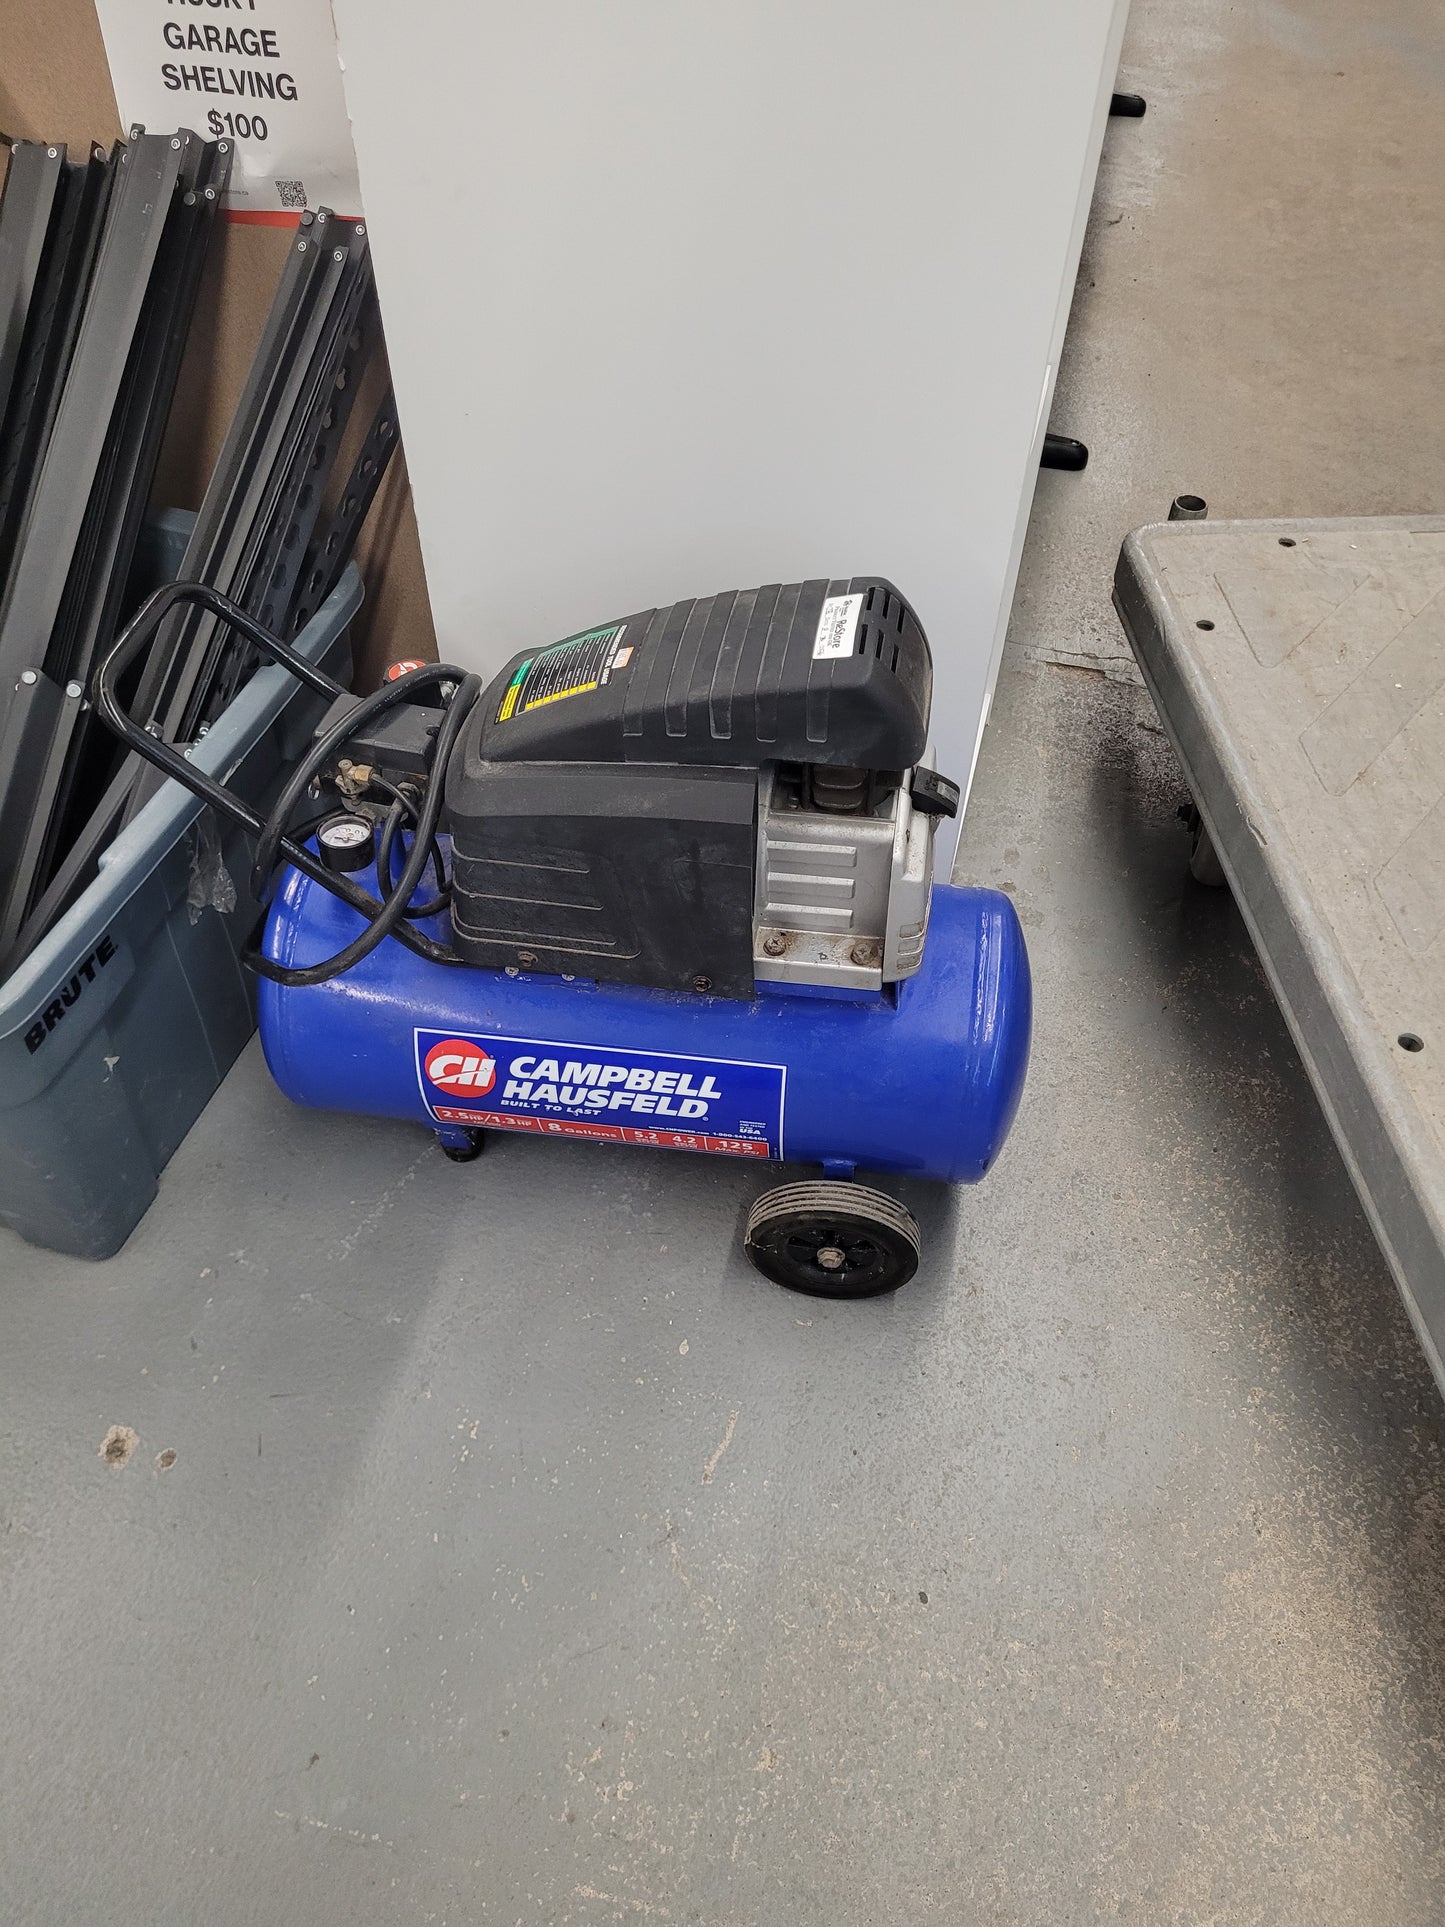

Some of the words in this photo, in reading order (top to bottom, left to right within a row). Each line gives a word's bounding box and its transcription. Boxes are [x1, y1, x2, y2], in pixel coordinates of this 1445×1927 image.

[163, 22, 280, 58] GARAGE
[161, 63, 298, 101] SHELVING
[207, 108, 268, 141] $100
[24, 935, 116, 1054] BRUTE
[509, 1056, 722, 1098] CAMPBELL
[500, 1100, 540, 1109] BUILT
[545, 1104, 562, 1112] TO
[566, 1107, 602, 1117] LAST
[502, 1080, 709, 1119] HAUSFELD
[548, 1123, 562, 1133] 8
[563, 1127, 617, 1139] Gallons
[634, 1131, 658, 1140] 5.2
[672, 1135, 697, 1144] 4.2
[719, 1140, 753, 1151] 125
